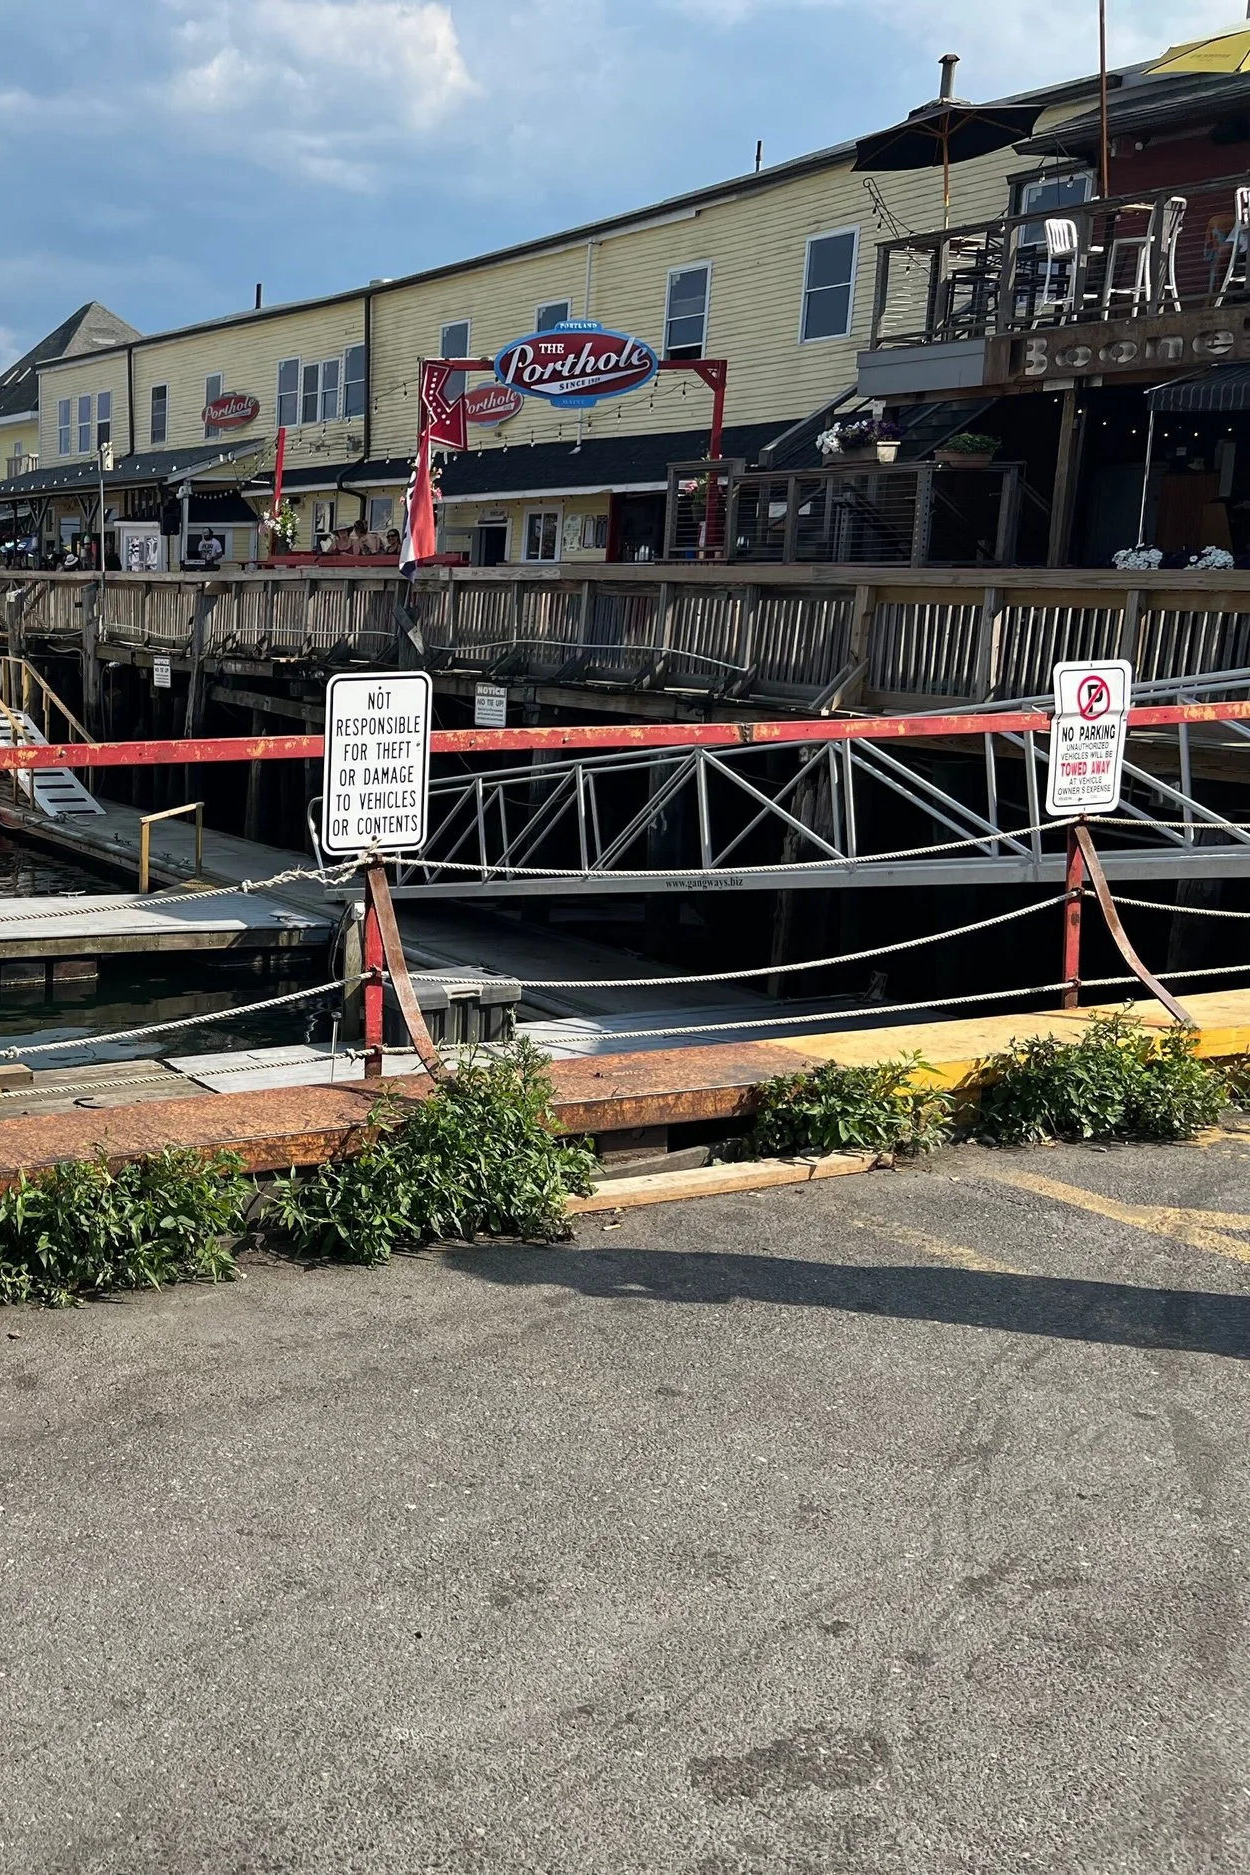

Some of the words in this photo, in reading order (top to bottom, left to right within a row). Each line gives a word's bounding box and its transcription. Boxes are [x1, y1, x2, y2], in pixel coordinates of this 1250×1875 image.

[539, 343, 565, 354] THE
[505, 337, 650, 384] Porthole
[559, 379, 586, 391] SINCE
[204, 396, 256, 423] Porthole
[477, 686, 505, 695] NOTICE
[368, 692, 391, 710] NOT
[477, 698, 486, 706] NO
[336, 716, 420, 737] RESPONSIBLE
[1062, 727, 1074, 742] NO
[1079, 724, 1116, 741] PARKING
[344, 743, 367, 761] FOR
[376, 741, 411, 759] THEFT
[1066, 741, 1109, 751] UNAUTHORIZED
[1061, 752, 1088, 761] VEHICLES
[1090, 751, 1103, 759] WILL
[1105, 750, 1113, 759] BE
[339, 768, 355, 786] OR
[364, 766, 414, 785] DAMAGE
[1060, 761, 1087, 777] TOWED
[1091, 760, 1111, 775] AWAY
[1069, 777, 1077, 785] AT
[1078, 776, 1102, 785] VEHICLE
[1086, 784, 1111, 794] EXPENSE
[336, 793, 350, 811] TO
[359, 790, 416, 810] VEHICLES
[332, 819, 349, 836] OR
[357, 814, 418, 835] CONTENTS
[665, 876, 744, 889] www.gangways.biz
